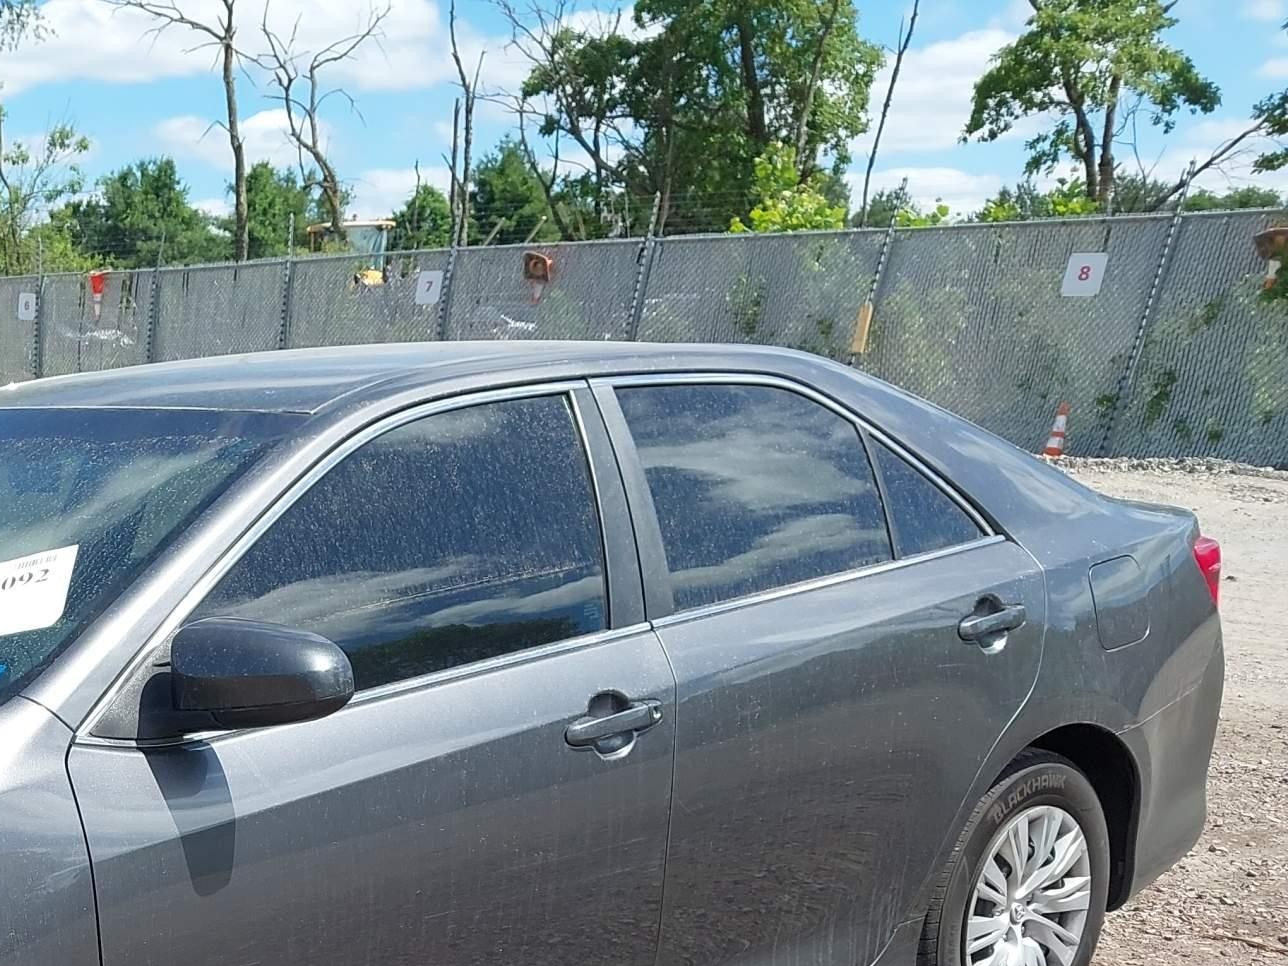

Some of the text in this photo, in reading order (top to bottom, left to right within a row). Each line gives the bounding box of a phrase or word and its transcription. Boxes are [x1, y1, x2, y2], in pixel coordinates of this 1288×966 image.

[1078, 265, 1091, 281] 8
[426, 280, 433, 292] 7
[993, 773, 1067, 825] BLACKHAWK
